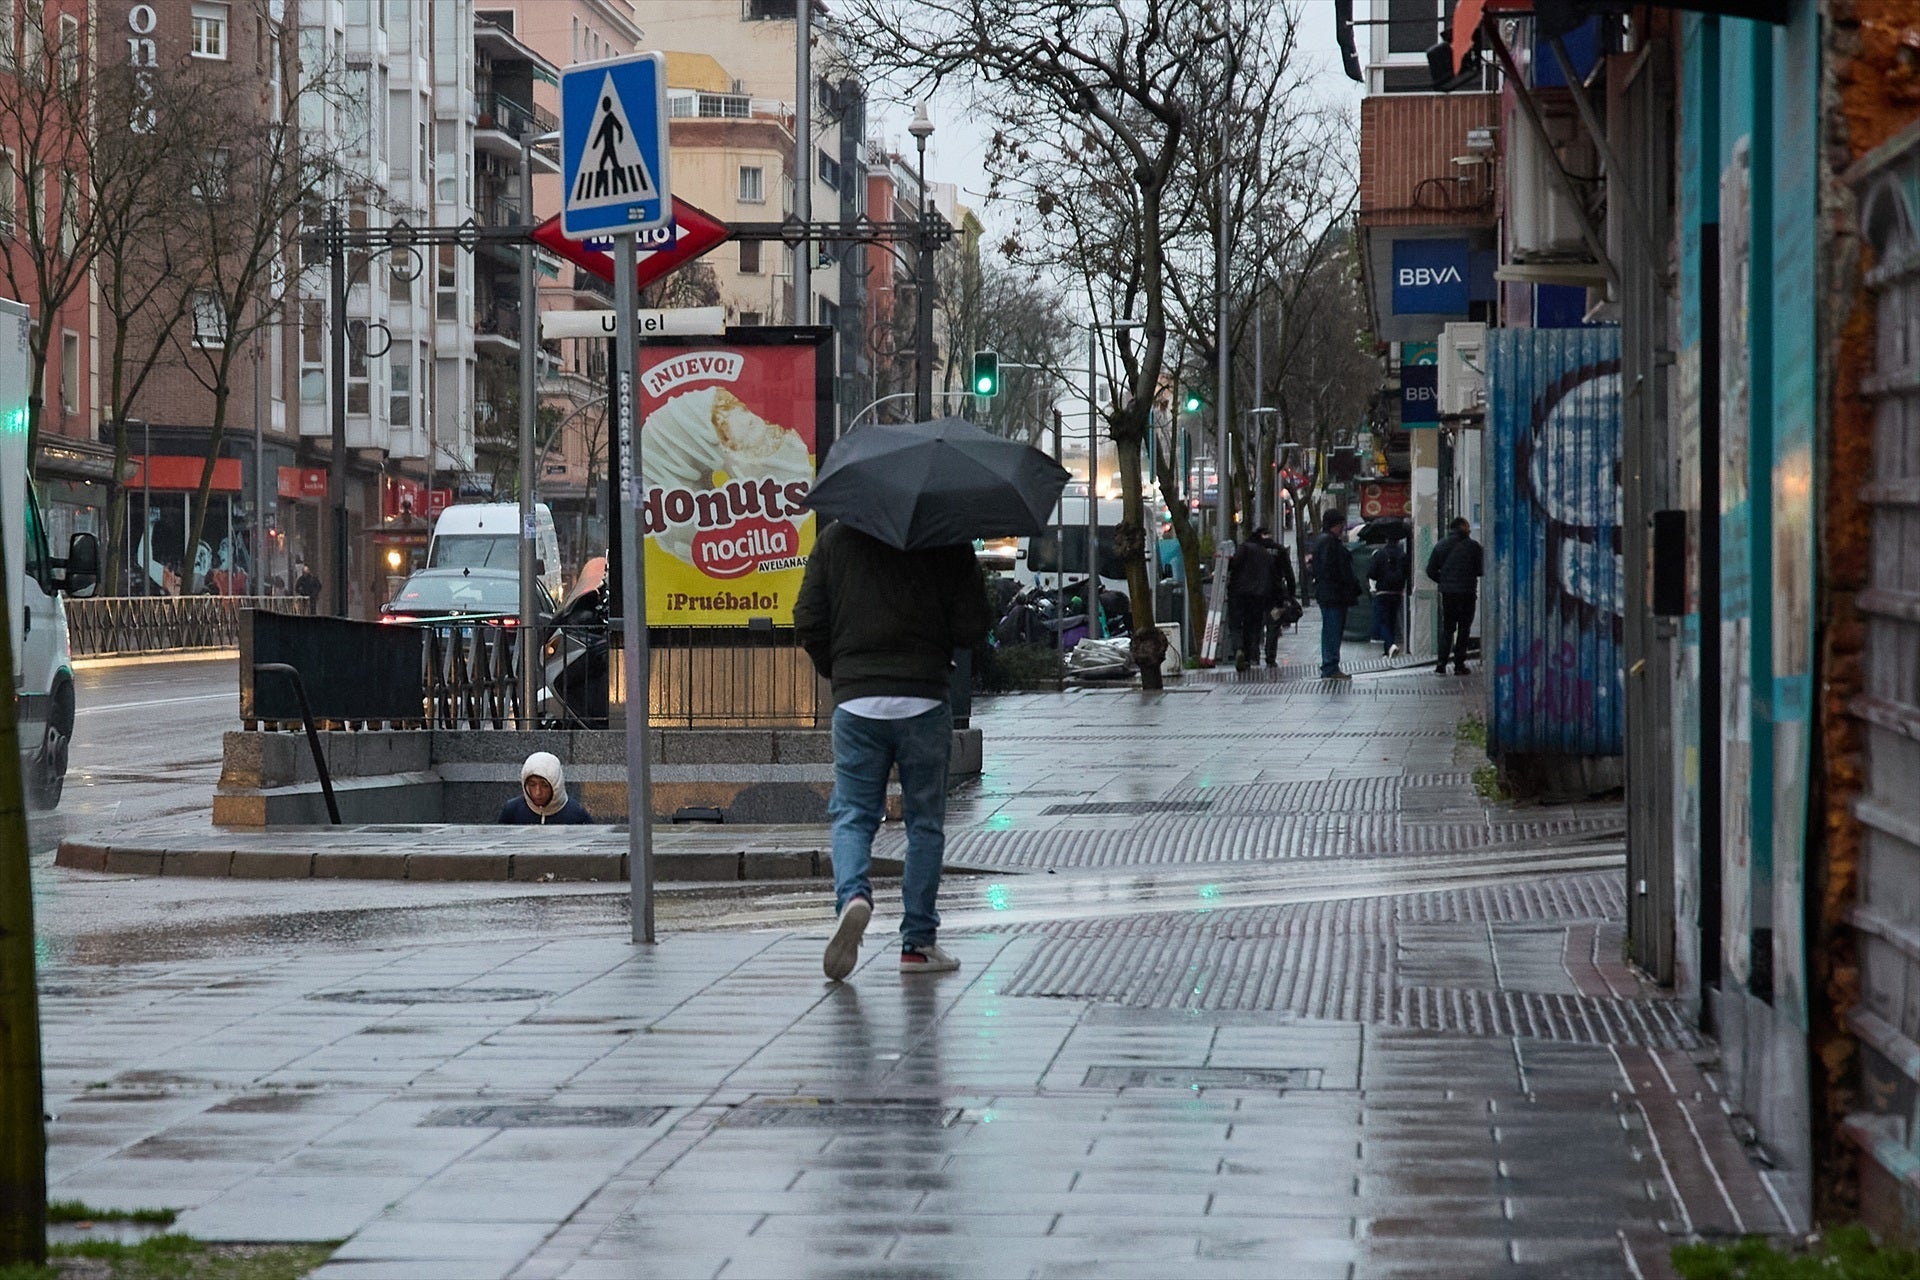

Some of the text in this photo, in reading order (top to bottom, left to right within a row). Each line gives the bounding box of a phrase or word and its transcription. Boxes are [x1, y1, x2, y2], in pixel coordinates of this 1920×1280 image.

[1400, 266, 1462, 286] BBVA
[602, 313, 664, 334] Uel
[651, 357, 734, 393] ¡NUEVO!
[1406, 387, 1439, 401] BBV
[643, 478, 810, 534] donuts
[702, 528, 788, 563] nocilla
[666, 591, 779, 611] ¡Pruébalo!
